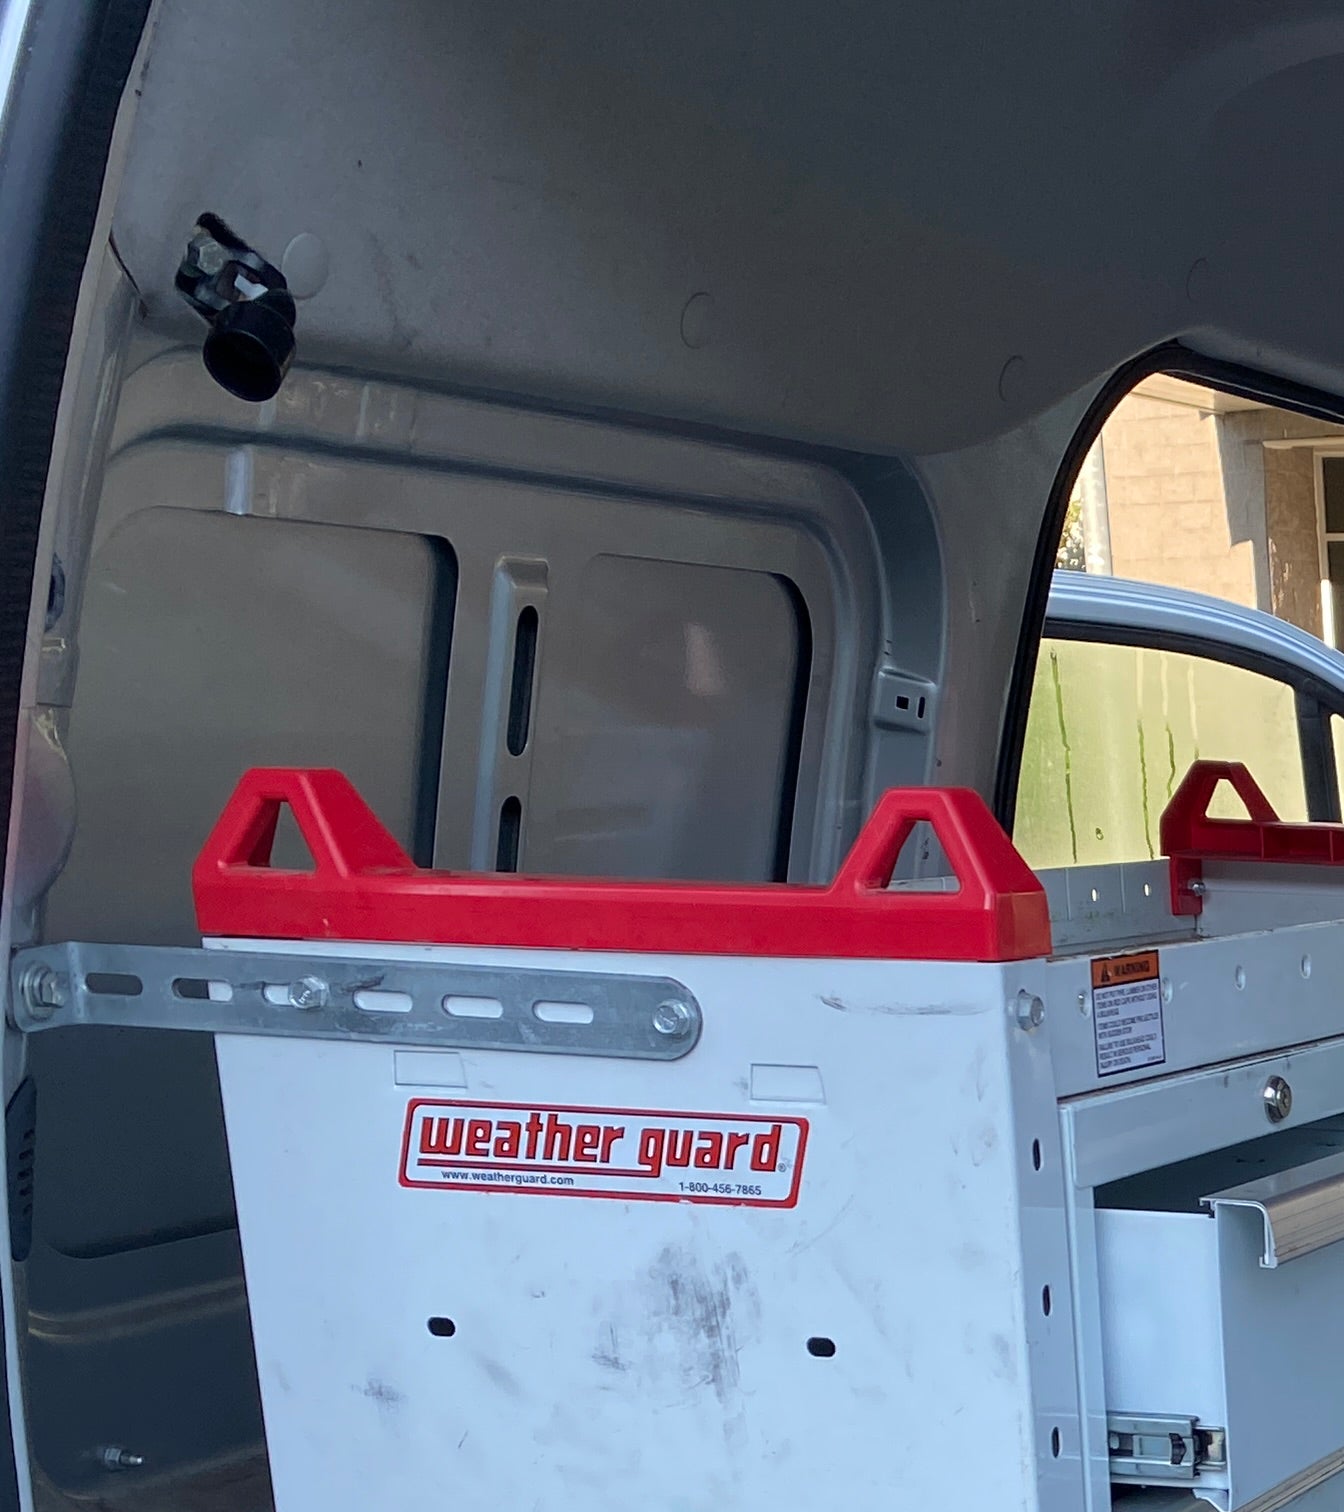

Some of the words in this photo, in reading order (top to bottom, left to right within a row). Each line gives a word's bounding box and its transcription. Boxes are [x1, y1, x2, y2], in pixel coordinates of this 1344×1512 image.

[1114, 960, 1150, 976] WARNING
[418, 1112, 625, 1163] weather
[637, 1124, 782, 1178] guard
[441, 1169, 575, 1187] www.weatherguard.com
[678, 1181, 762, 1196] 1-800-456-7865
